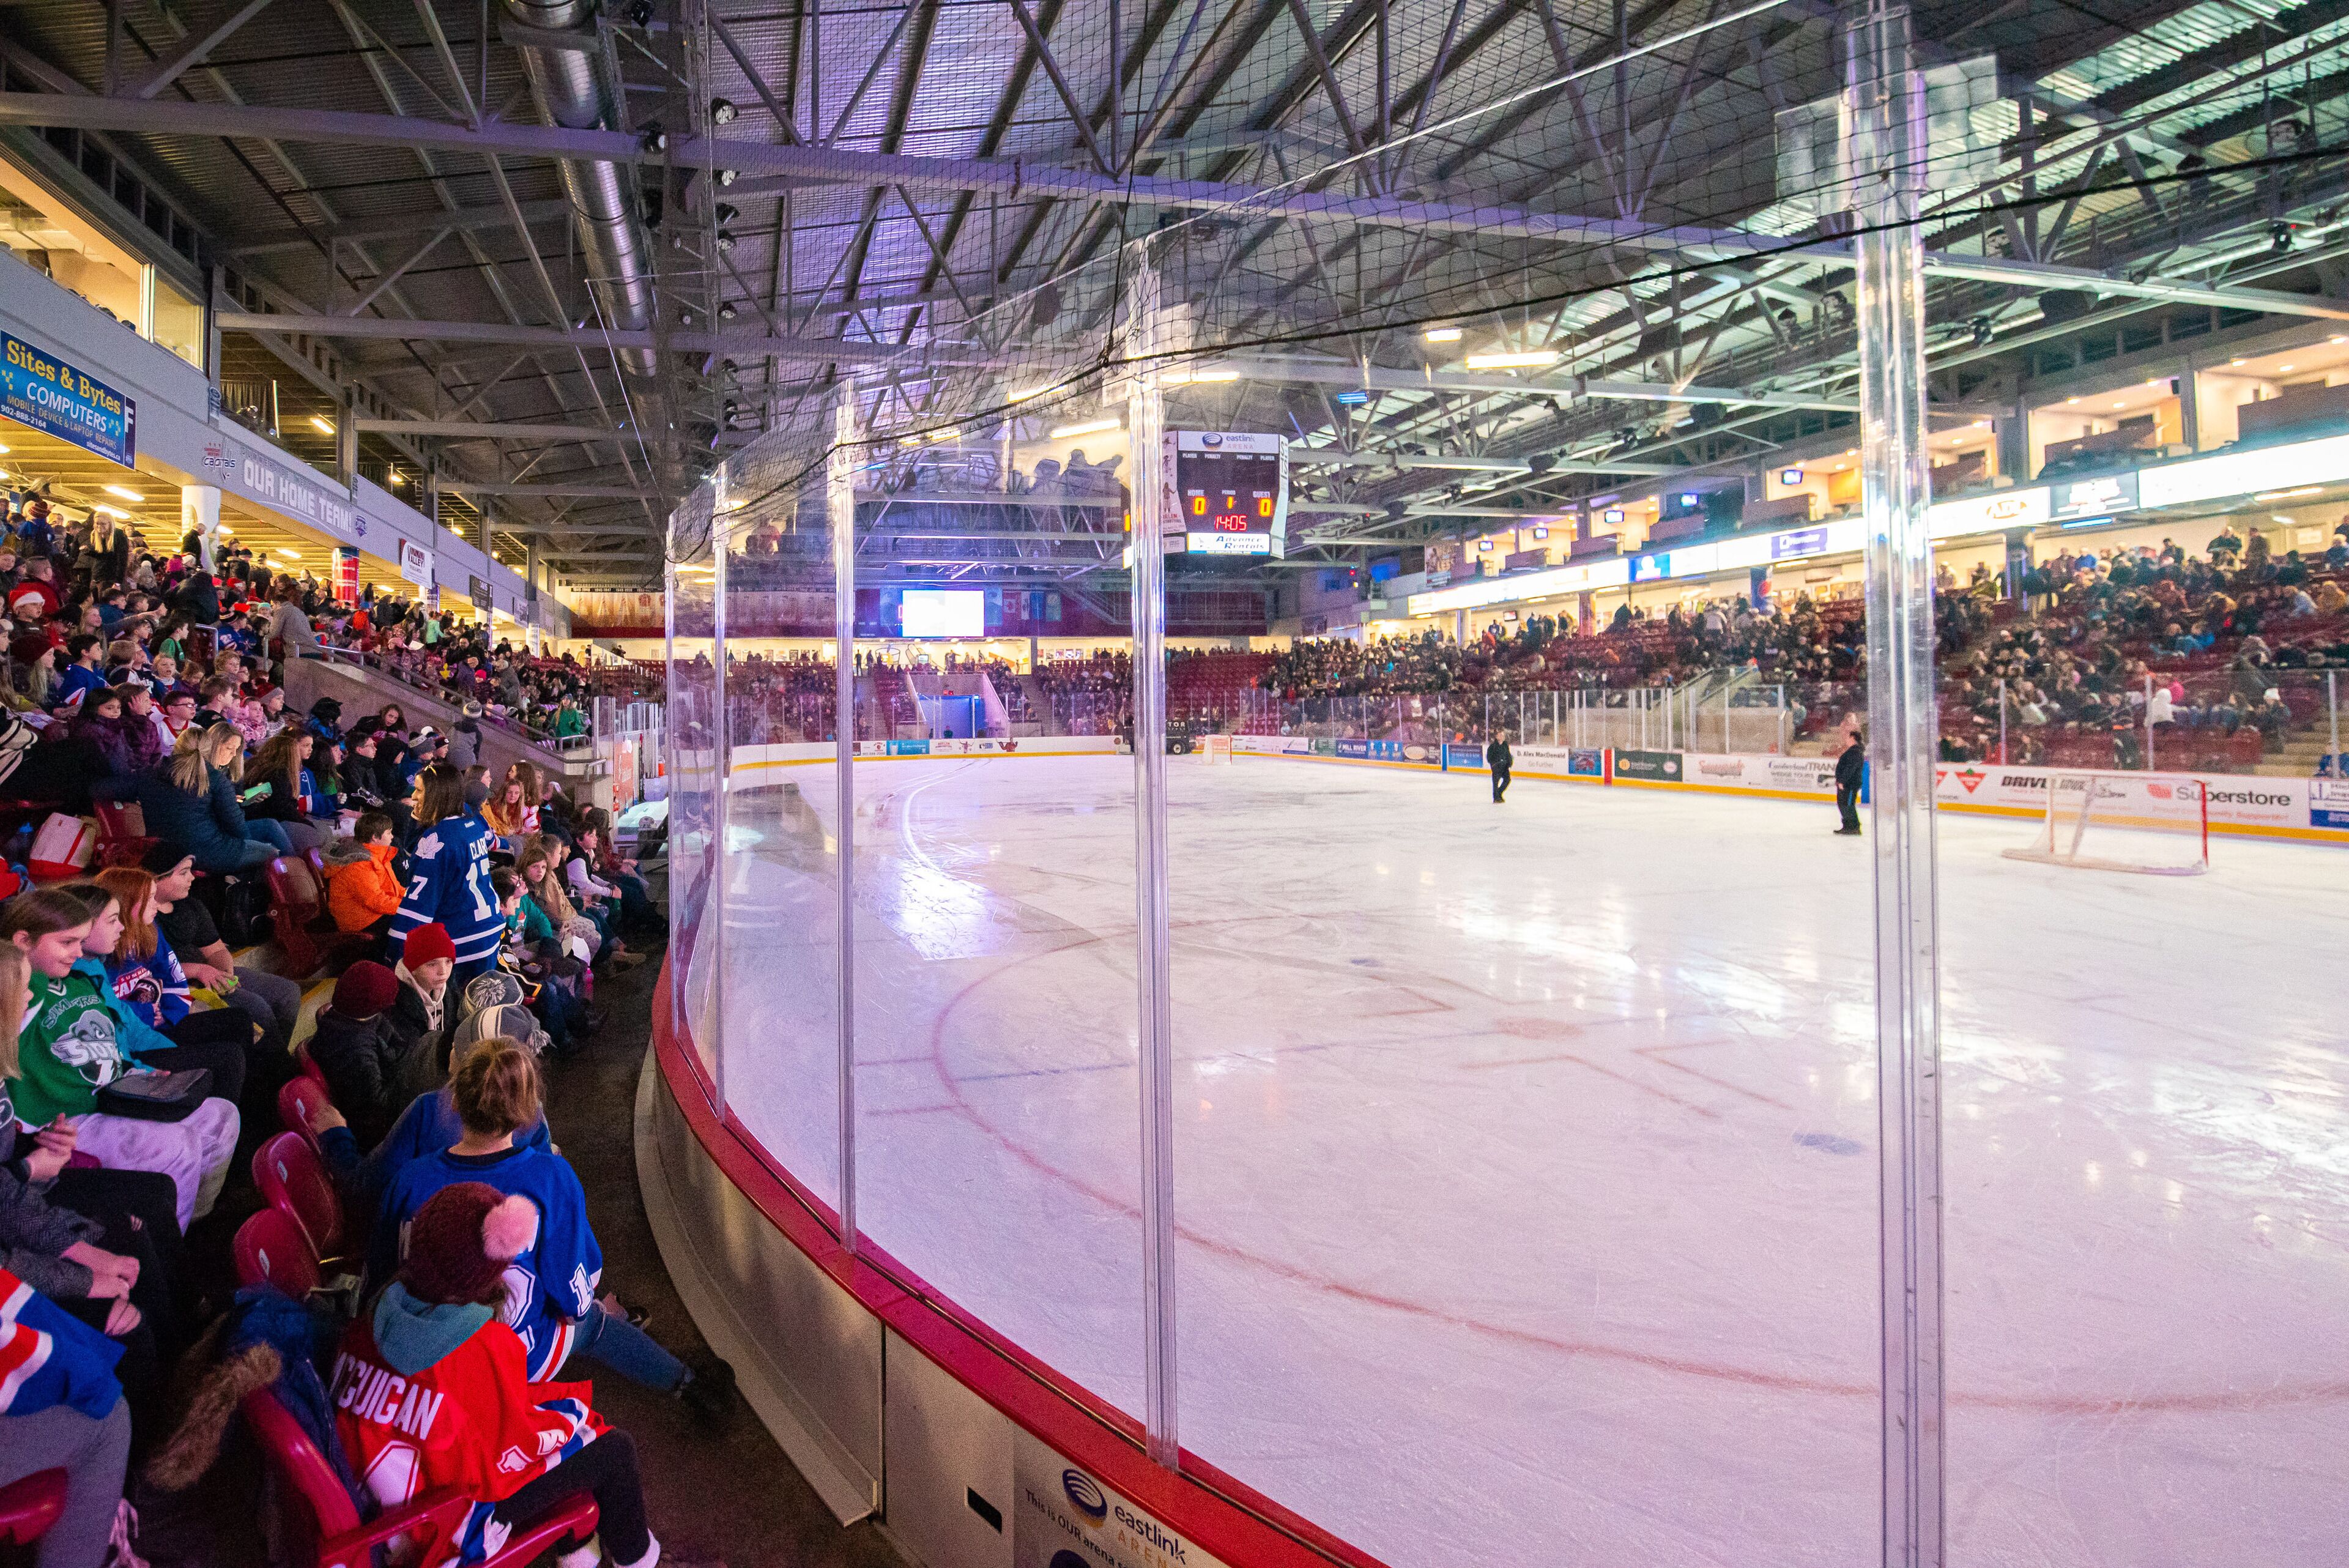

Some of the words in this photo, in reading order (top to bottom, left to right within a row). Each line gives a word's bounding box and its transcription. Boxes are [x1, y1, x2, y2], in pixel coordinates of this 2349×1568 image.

[7, 340, 56, 382] Sites
[60, 366, 74, 392] &
[78, 375, 121, 415] Bytes
[1, 404, 47, 429] 902-888-2164
[7, 395, 35, 415] MOBILE
[39, 407, 63, 425] DEVICE
[70, 420, 93, 438] LAPTOP
[95, 433, 117, 450] REPAIRS
[26, 382, 107, 433] COMPUTERS
[86, 440, 121, 461] sitesandbytes.ca
[1226, 434, 1256, 442] eastlink
[243, 459, 275, 497] OUR
[279, 477, 315, 516] HOME
[319, 497, 352, 533] TEAM!
[1193, 497, 1206, 515] 0
[1259, 498, 1272, 517] 0
[1215, 515, 1247, 532] 14:05
[407, 546, 425, 568] VALLEY
[2176, 787, 2291, 806] Superstore
[1025, 1488, 1046, 1514] This
[1047, 1506, 1056, 1522] is
[1058, 1515, 1082, 1541] OUR
[1083, 1536, 1115, 1566] arena
[1114, 1505, 1186, 1566] eastlink
[1118, 1529, 1168, 1568] AREN
